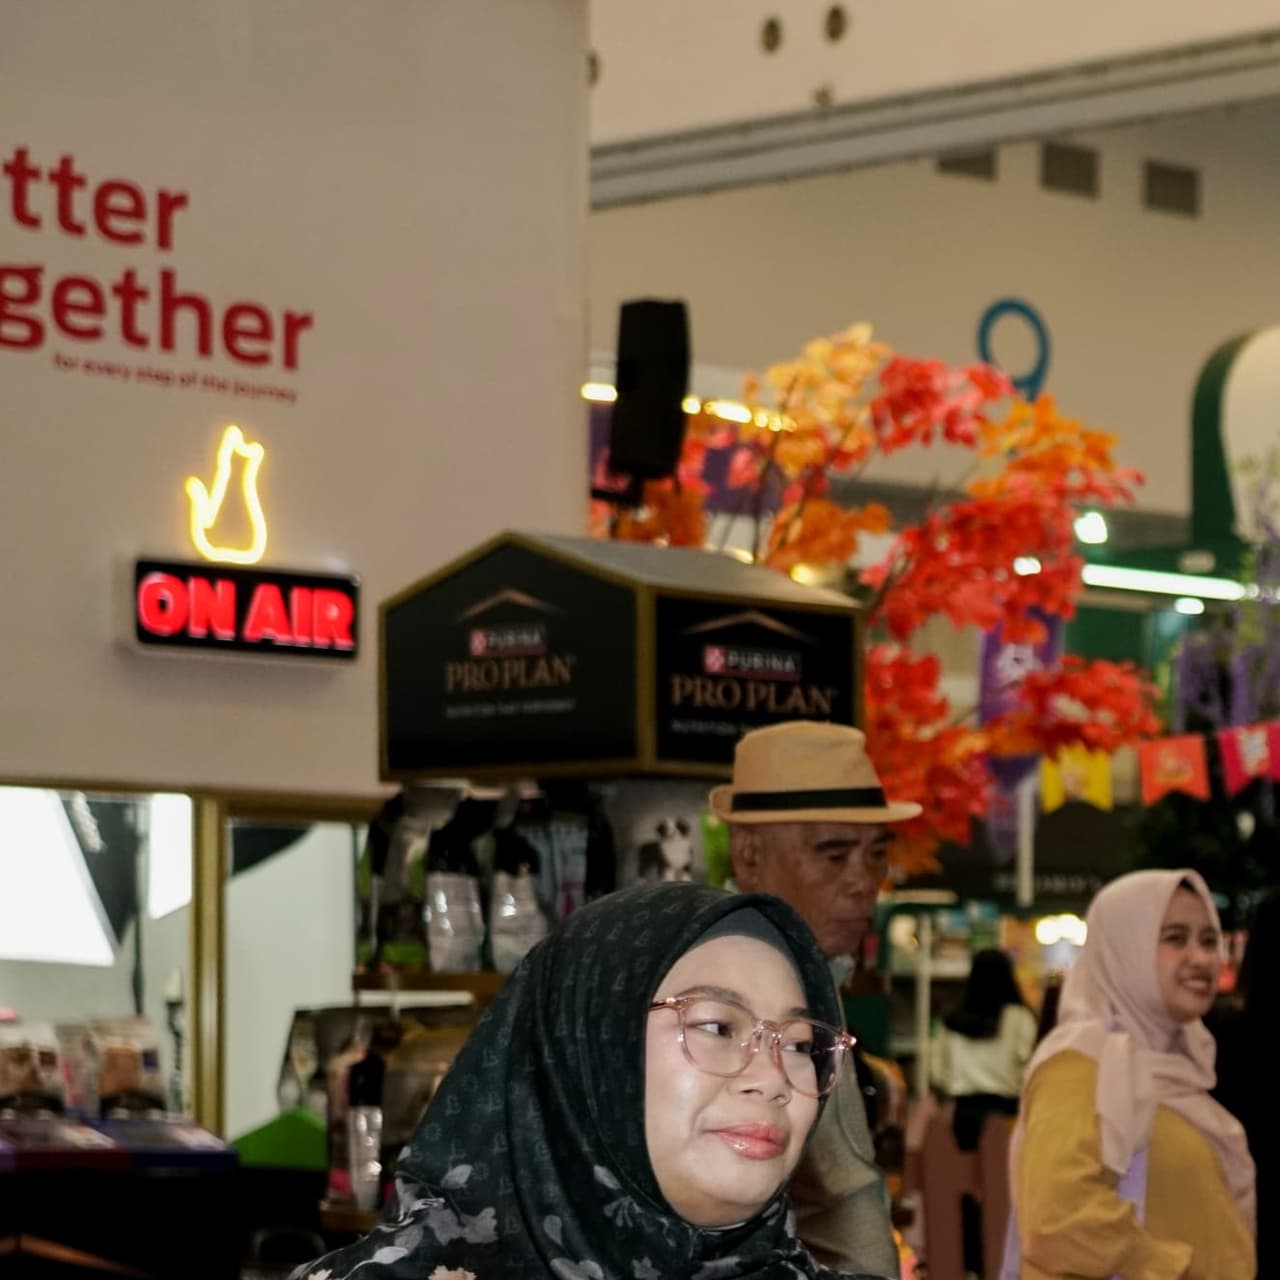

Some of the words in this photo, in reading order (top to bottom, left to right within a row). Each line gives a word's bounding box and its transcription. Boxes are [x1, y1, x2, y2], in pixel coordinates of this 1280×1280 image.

[2, 146, 189, 251] tter
[0, 264, 313, 371] gether
[138, 571, 236, 640] ON
[243, 583, 354, 651] AIR
[446, 660, 499, 692] PRO
[727, 651, 796, 672] PURINA
[671, 673, 741, 709] PRO
[745, 680, 833, 714] PLAN
